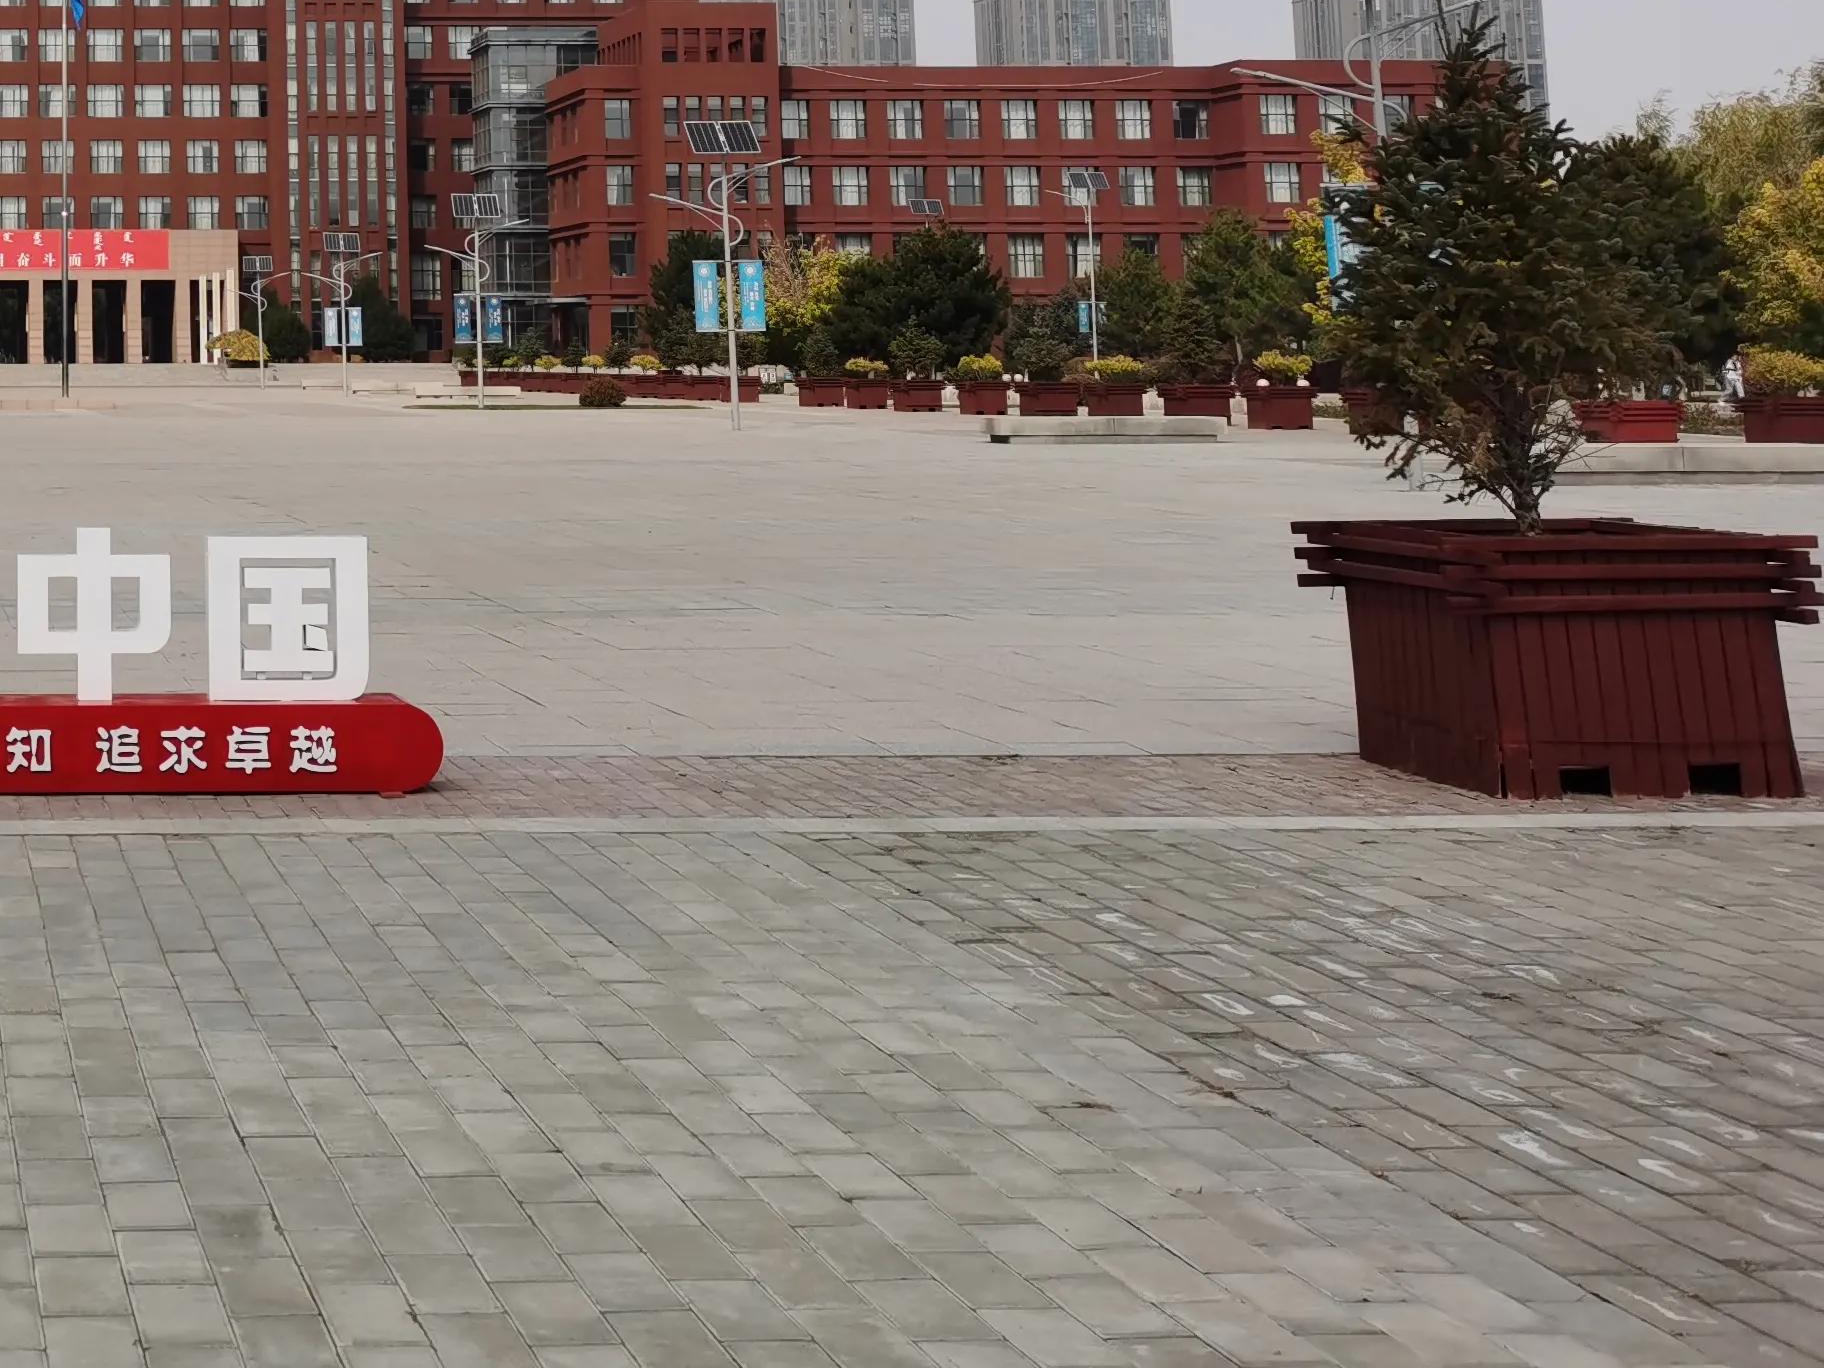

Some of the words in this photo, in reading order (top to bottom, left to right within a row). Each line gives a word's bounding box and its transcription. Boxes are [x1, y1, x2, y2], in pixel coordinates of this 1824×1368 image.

[18, 528, 368, 703] 中国
[95, 725, 338, 775] 追求卓越
